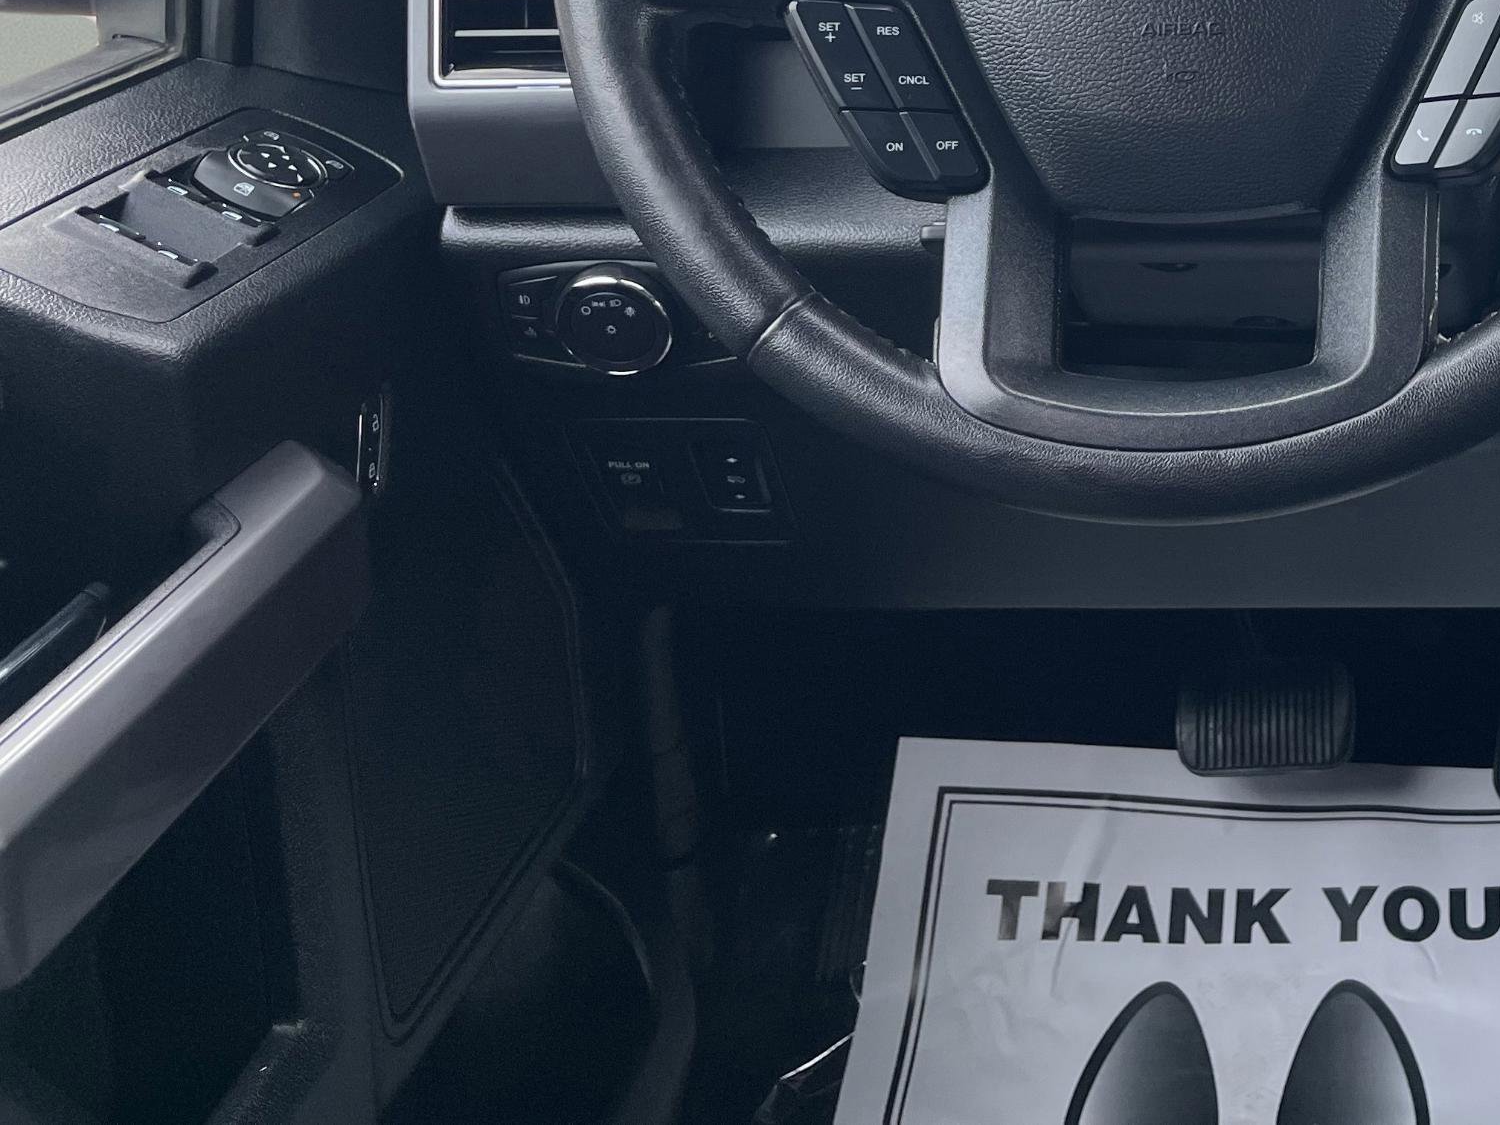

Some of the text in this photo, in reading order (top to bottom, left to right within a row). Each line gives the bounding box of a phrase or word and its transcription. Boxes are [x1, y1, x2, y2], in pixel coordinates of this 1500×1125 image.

[818, 22, 841, 32] SET
[876, 26, 900, 36] RES
[844, 73, 866, 82] SET
[898, 75, 930, 85] CNCL
[886, 142, 904, 151] ON
[936, 141, 959, 150] OFF
[986, 879, 1292, 945] THANK
